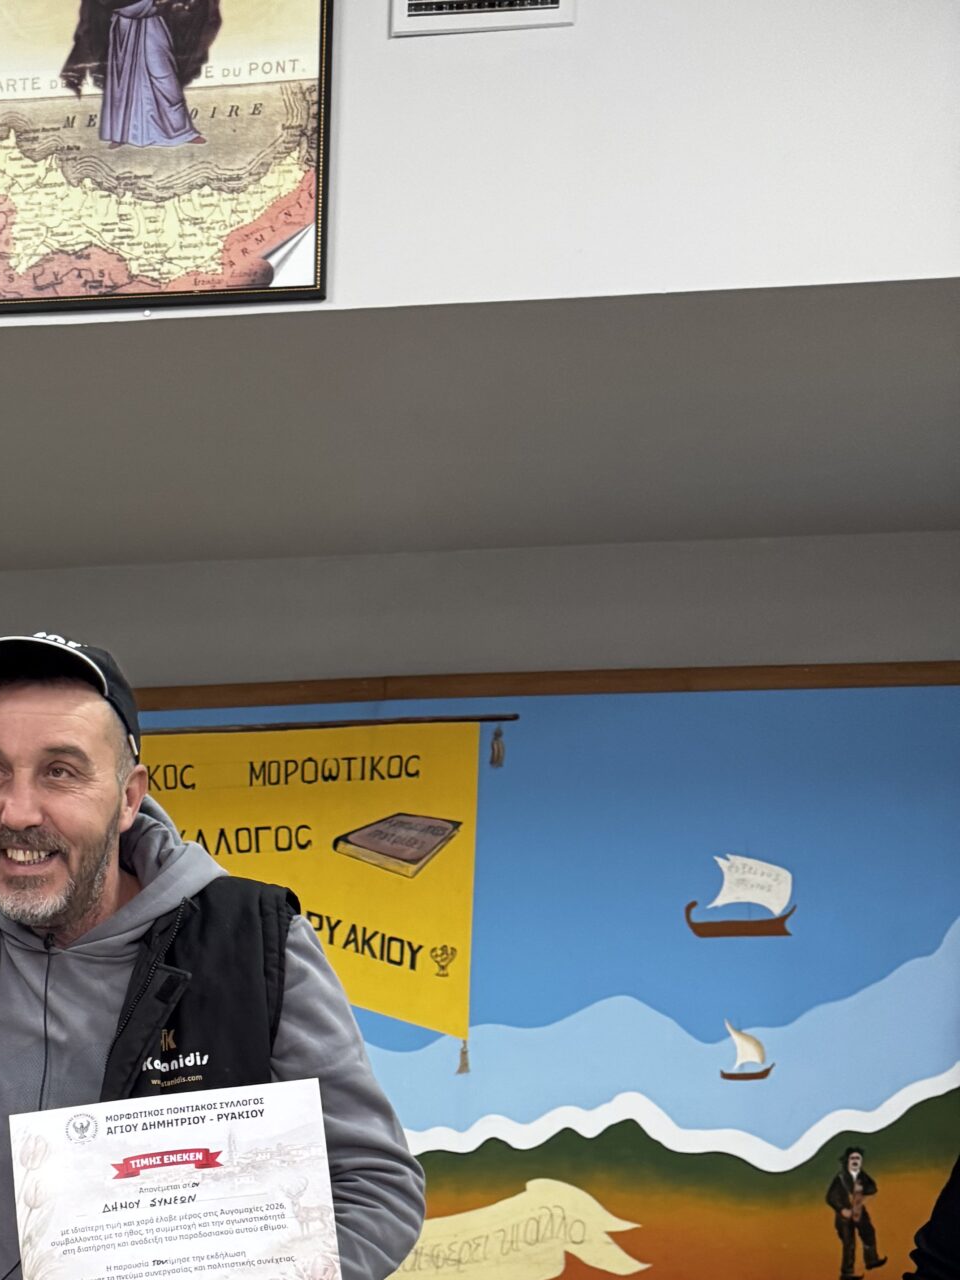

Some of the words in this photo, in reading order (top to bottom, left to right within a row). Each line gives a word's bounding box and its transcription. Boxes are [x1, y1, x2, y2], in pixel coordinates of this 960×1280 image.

[221, 67, 241, 78] DU
[189, 102, 263, 120] OIRE
[142, 1051, 209, 1072] Koanidis
[105, 1108, 165, 1122] ΜΟΡΦΩΤΙΚΟΣ
[166, 1102, 218, 1114] ΠΟΝΤΙΑΚΟΣ
[219, 1097, 265, 1109] ΣΥΛΛΟΓΟΣ
[106, 1123, 138, 1136] ΑΓΙΟΥ
[141, 1115, 206, 1131] ΔΗΜΗΤΡΙΟΥ
[216, 1108, 265, 1122] ΡΥΑΚΙΟΥ
[129, 1157, 162, 1169] ΤΙΜΗΣ
[163, 1151, 204, 1164] ΕΝΕΚΕΝ
[50, 1234, 102, 1248] συμβάλλοντας
[103, 1232, 113, 1241] με
[155, 1221, 197, 1234] συμμετοχή
[211, 1219, 224, 1229] την
[60, 1229, 70, 1237] με
[71, 1222, 104, 1234] ιδιαίτερη
[105, 1221, 122, 1230] τιμή
[123, 1219, 135, 1227] και
[178, 1211, 202, 1222] μέρος
[77, 1240, 116, 1253] διατήρηση
[117, 1239, 129, 1248] και
[164, 1233, 178, 1242] του
[113, 1259, 149, 1272] παρουσία
[191, 1254, 205, 1263] την
[206, 1249, 246, 1260] εκδήλωση
[193, 1265, 206, 1273] και
